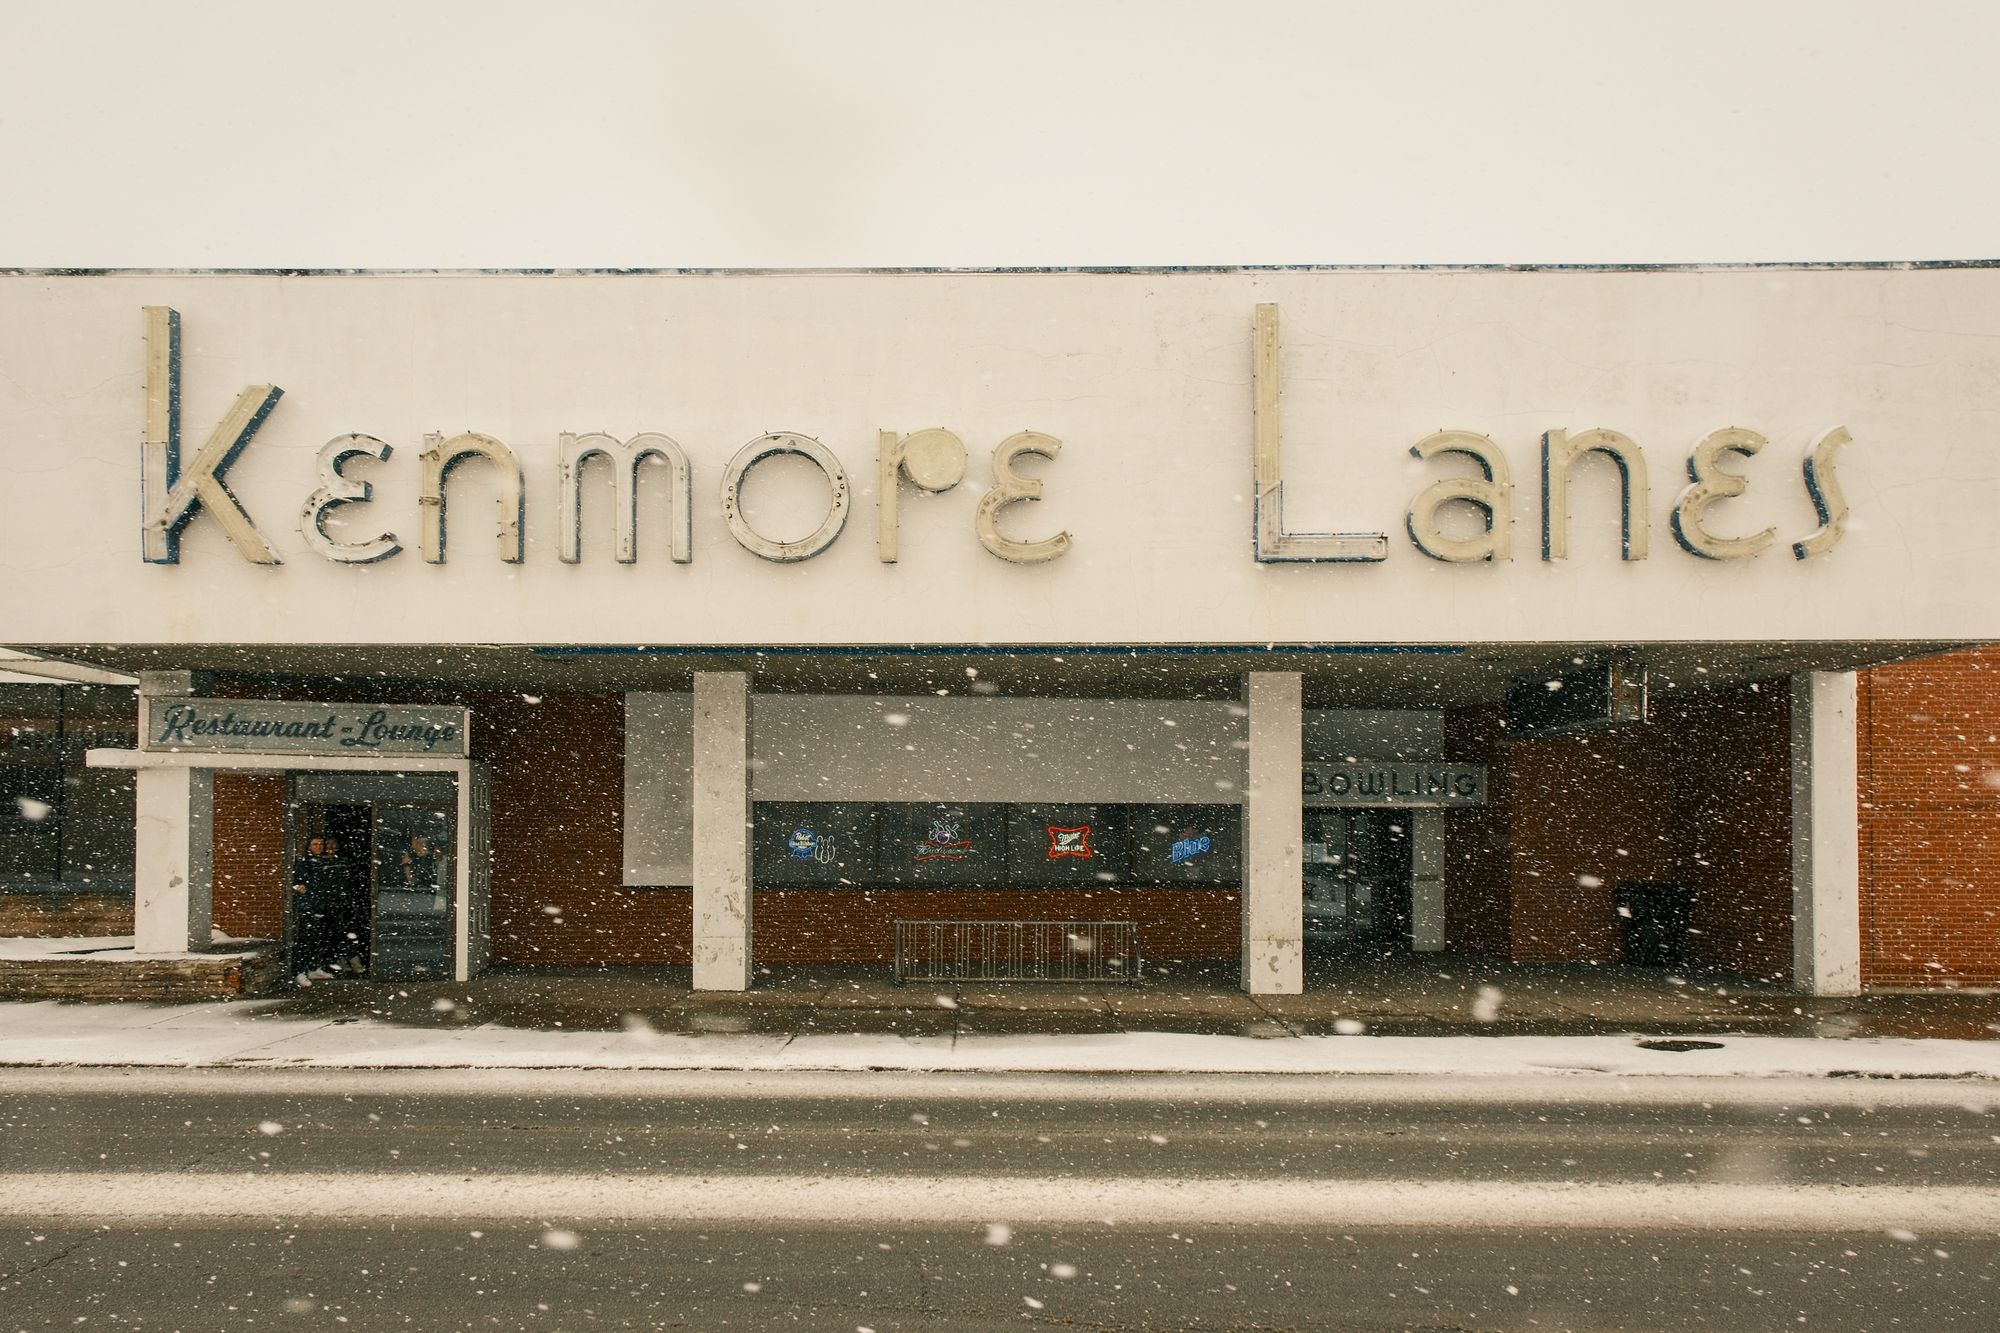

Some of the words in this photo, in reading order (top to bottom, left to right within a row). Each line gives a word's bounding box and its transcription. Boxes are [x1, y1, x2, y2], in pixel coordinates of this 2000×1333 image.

[1253, 302, 1852, 562] Lanes
[1303, 772, 1476, 795] BOWLING
[1172, 836, 1210, 863] Blue
